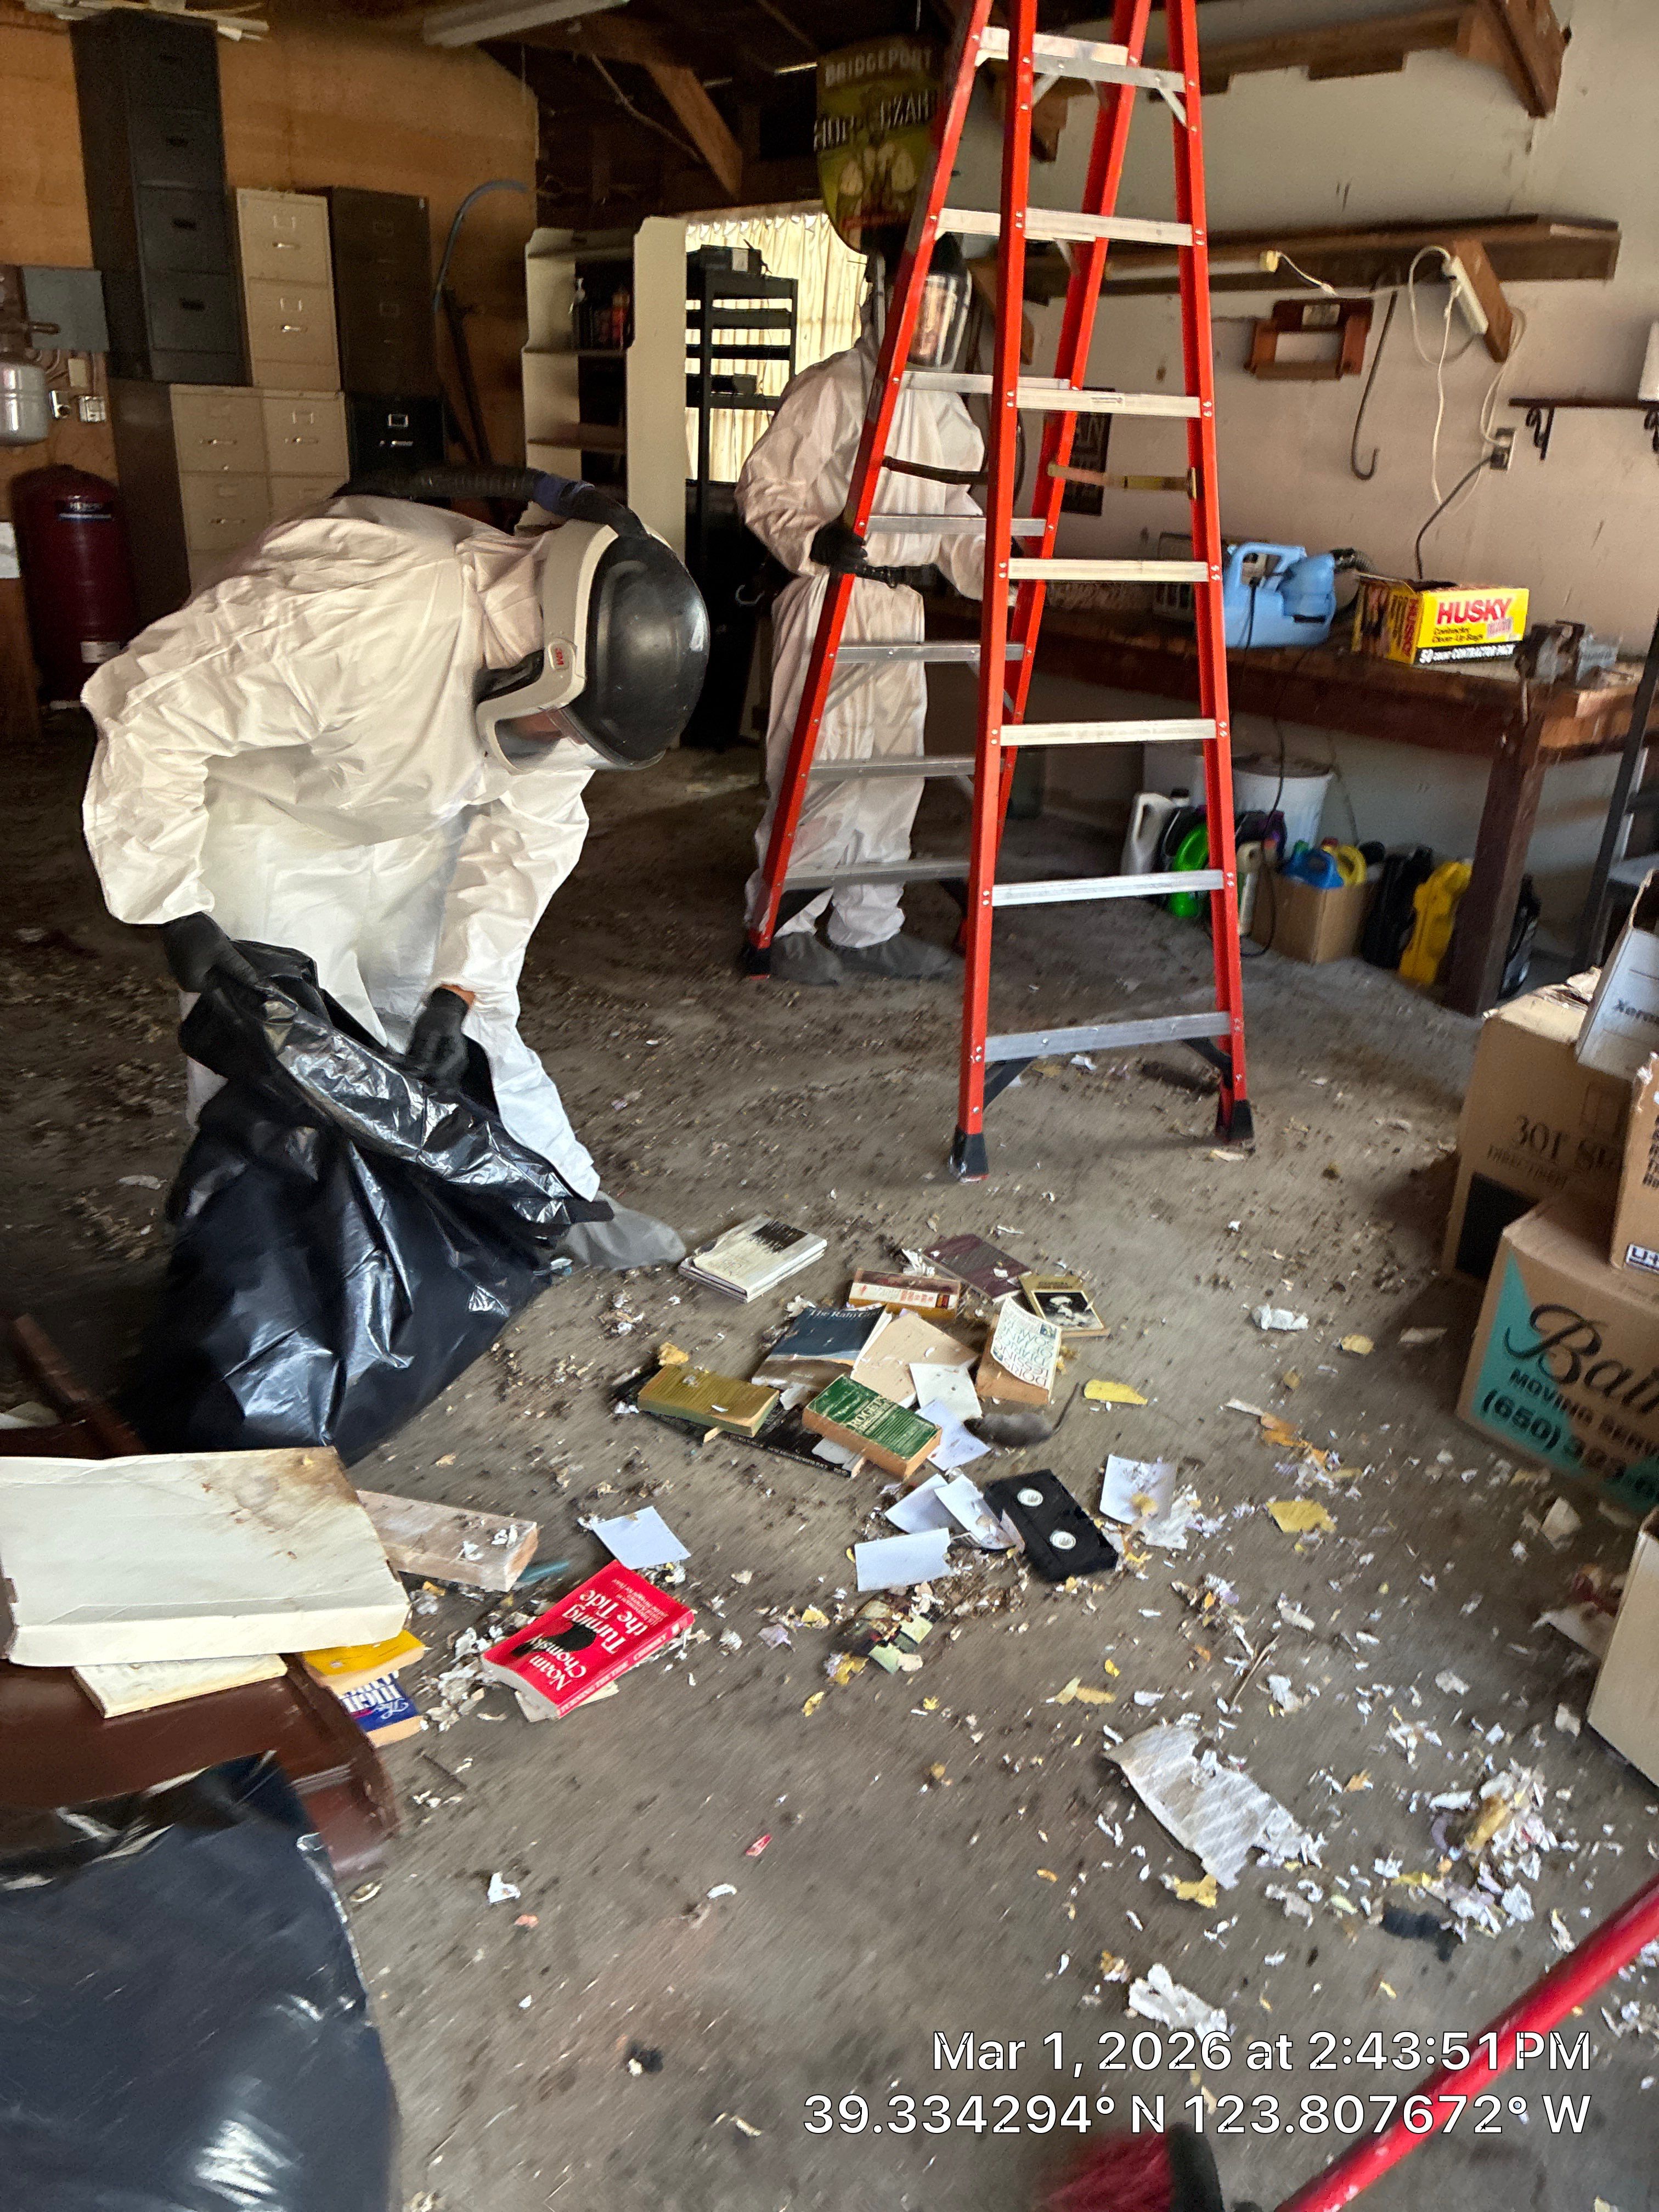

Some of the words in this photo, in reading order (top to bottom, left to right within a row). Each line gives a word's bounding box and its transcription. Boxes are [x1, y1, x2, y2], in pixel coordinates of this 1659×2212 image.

[825, 46, 931, 88] BRIDGEPORT
[1437, 597, 1512, 624] HUSKY
[1419, 648, 1434, 664] 50
[808, 1308, 831, 1318] The
[830, 1309, 856, 1318] Rain
[995, 1337, 1049, 1377] LESSING
[1004, 1358, 1047, 1387] DORIS
[1509, 1368, 1594, 1426] MOVING
[1481, 1388, 1562, 1452] (650)
[579, 1589, 619, 1620] Tide
[561, 1604, 626, 1655] Turning
[616, 1611, 648, 1637] the
[528, 1654, 572, 1691] Noam
[529, 1633, 586, 1678] Chomsky
[375, 1697, 409, 1720] The
